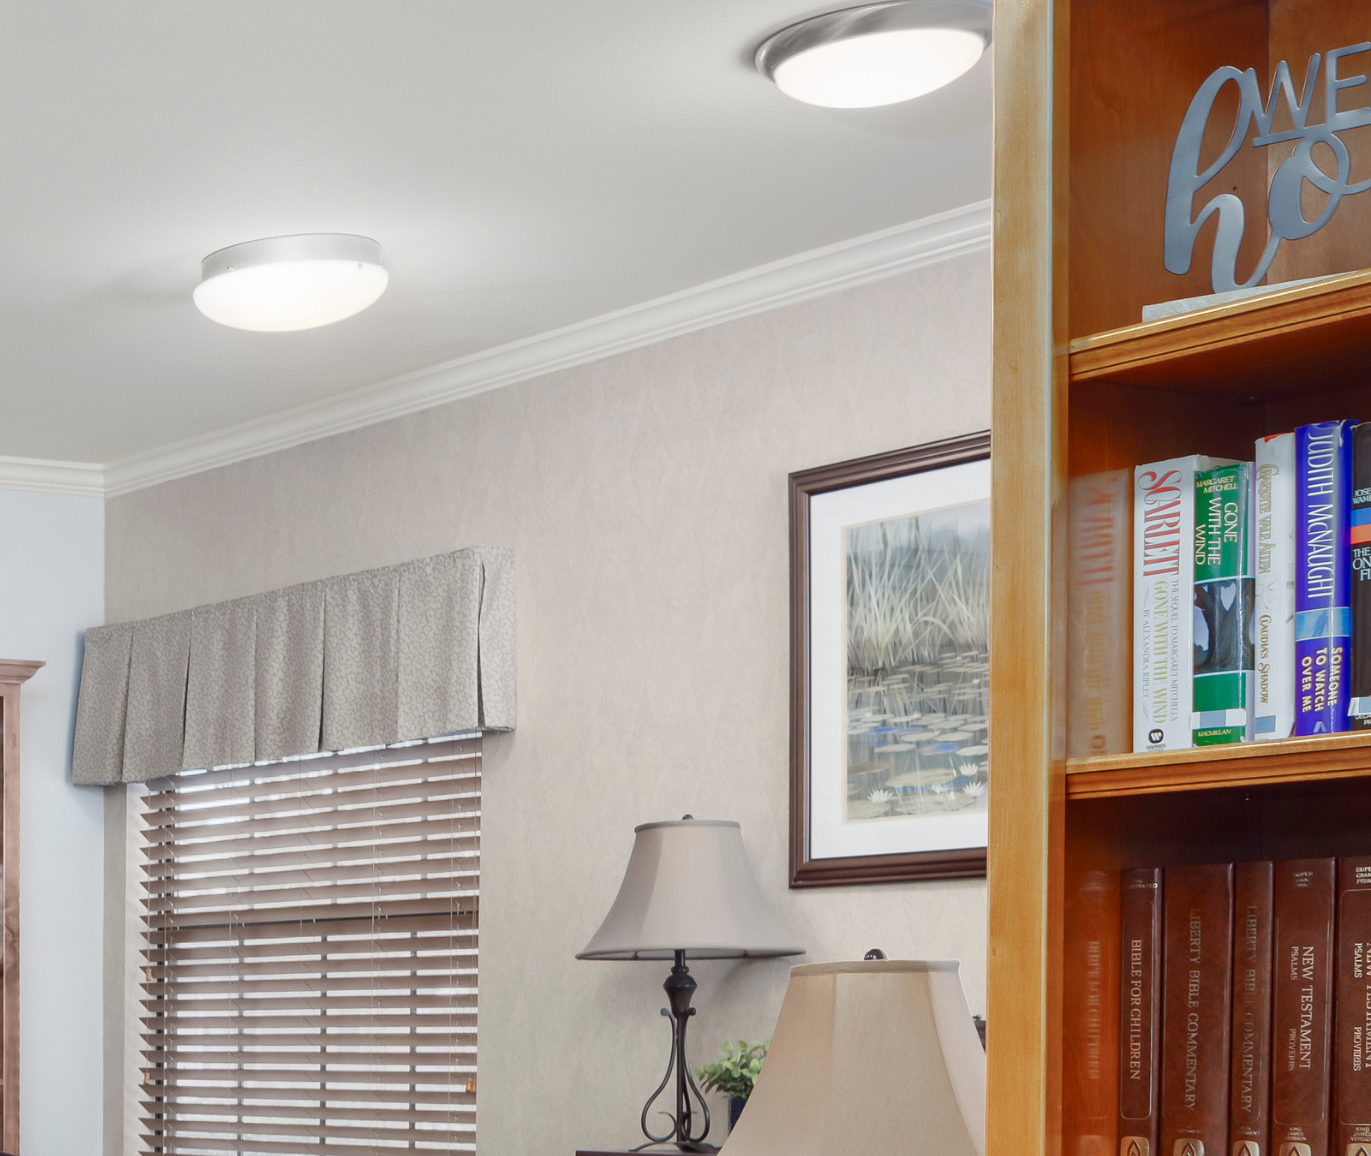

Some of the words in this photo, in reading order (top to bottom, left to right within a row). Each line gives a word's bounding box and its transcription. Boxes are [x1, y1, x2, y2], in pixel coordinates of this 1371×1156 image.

[1195, 474, 1236, 488] MARGARET
[1307, 431, 1335, 497] JUDITH
[1203, 482, 1239, 494] MITCHELL
[1138, 470, 1183, 578] SCARLETT
[1208, 496, 1222, 538] WITH
[1223, 502, 1239, 544] GONE
[1257, 516, 1272, 541] VALE
[1195, 524, 1207, 566] WIND
[1207, 540, 1221, 566] THE
[1153, 581, 1169, 618] GONE
[1170, 579, 1180, 593] THE
[1142, 610, 1151, 619] BY
[1170, 594, 1179, 623] SEQUEL
[1141, 620, 1151, 671] ALEXANDRA
[1153, 620, 1169, 660] WITH
[1170, 624, 1179, 635] TO
[1259, 615, 1272, 660] CLAUDIA'S
[1153, 660, 1169, 686] THE
[1170, 636, 1179, 678] MARGARET
[1301, 657, 1313, 692] OVER
[1315, 649, 1328, 666] TO
[1141, 673, 1150, 699] RIPLEY
[1257, 663, 1271, 705] SHADOW
[1313, 669, 1326, 713] WATCH
[1327, 648, 1344, 707] SOMEONE
[1153, 688, 1168, 724] WIND
[1170, 678, 1179, 722] MITCHELL'S
[1301, 696, 1313, 714] ME
[1189, 908, 1201, 964] LIBERTY
[1130, 938, 1142, 978] BIBLE
[1290, 946, 1299, 980] PSALMS
[1301, 946, 1314, 980] NEW
[1353, 942, 1363, 978] PSALMS
[1130, 980, 1142, 1006] FOR
[1188, 970, 1200, 1008] BIBLE
[1129, 1008, 1141, 1080] CHILDREN
[1299, 984, 1313, 1070] TESTAMENT
[1185, 1012, 1199, 1110] COMMENTARY
[1287, 1028, 1297, 1072] PROVERBS
[1353, 1026, 1363, 1072] PROVERBS
